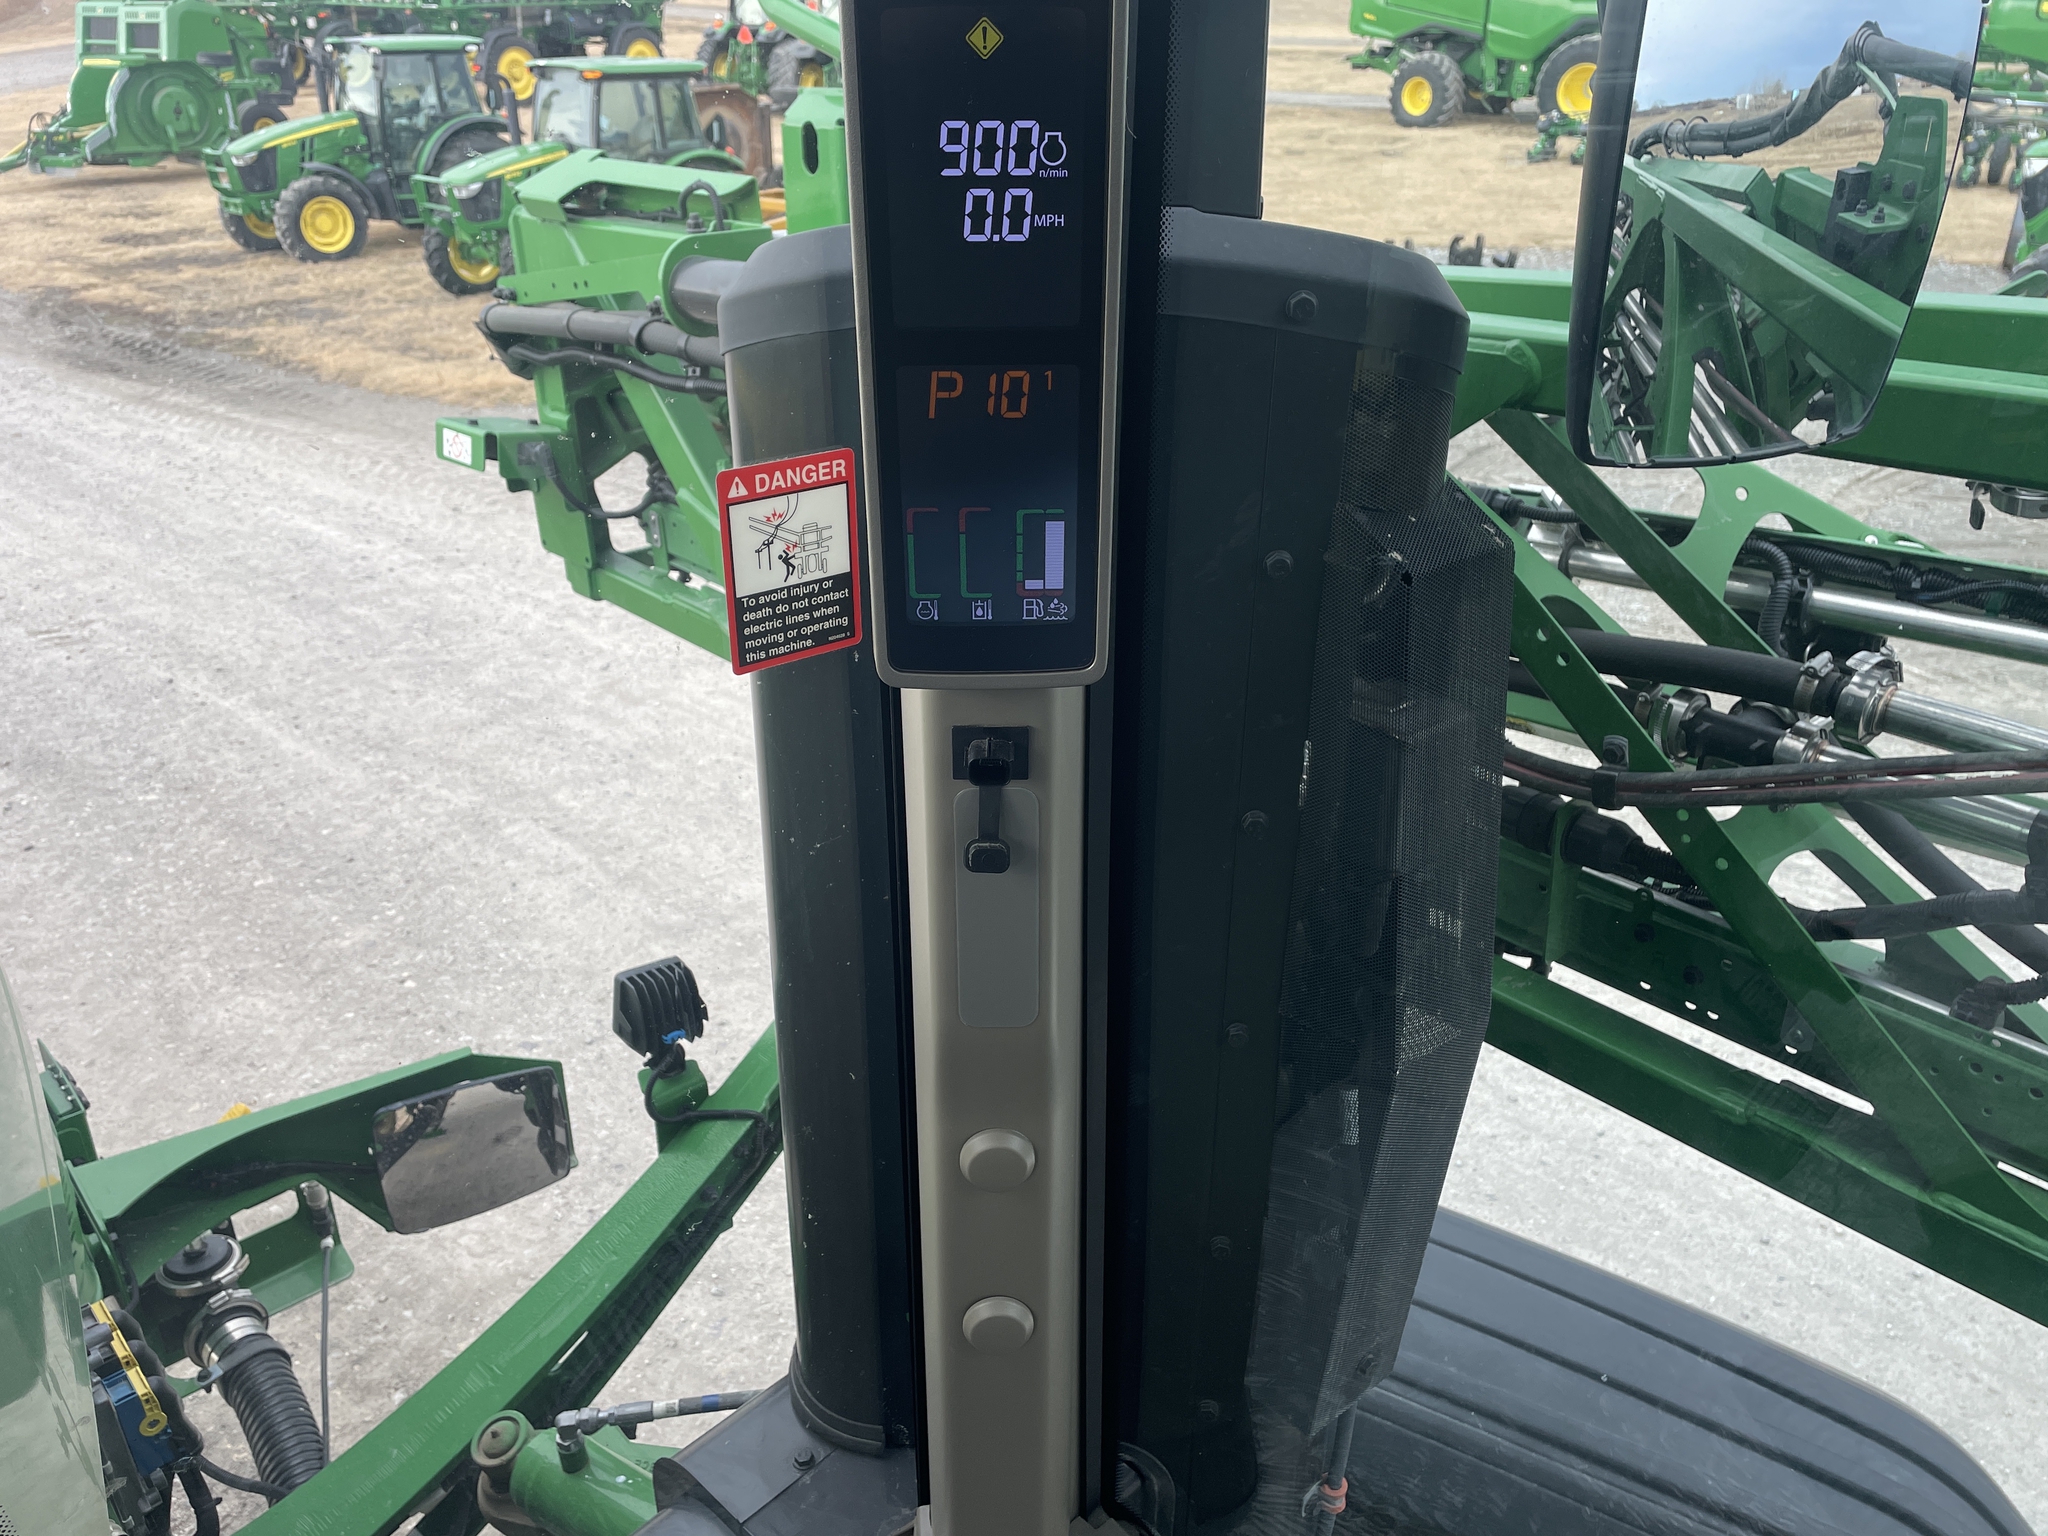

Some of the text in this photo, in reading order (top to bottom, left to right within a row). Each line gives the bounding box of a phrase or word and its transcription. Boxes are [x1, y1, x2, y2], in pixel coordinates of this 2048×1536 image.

[939, 120, 1068, 178] 900 n/min
[963, 188, 1065, 242] 0.0 MPH
[928, 370, 1053, 419] P 10 1
[755, 459, 847, 494] DANGER
[741, 580, 833, 608] To avoid injury or
[743, 588, 849, 622] death do not contact
[744, 605, 840, 635] electric lines when
[745, 616, 849, 649] moving or operating
[746, 638, 816, 663] this machine.
